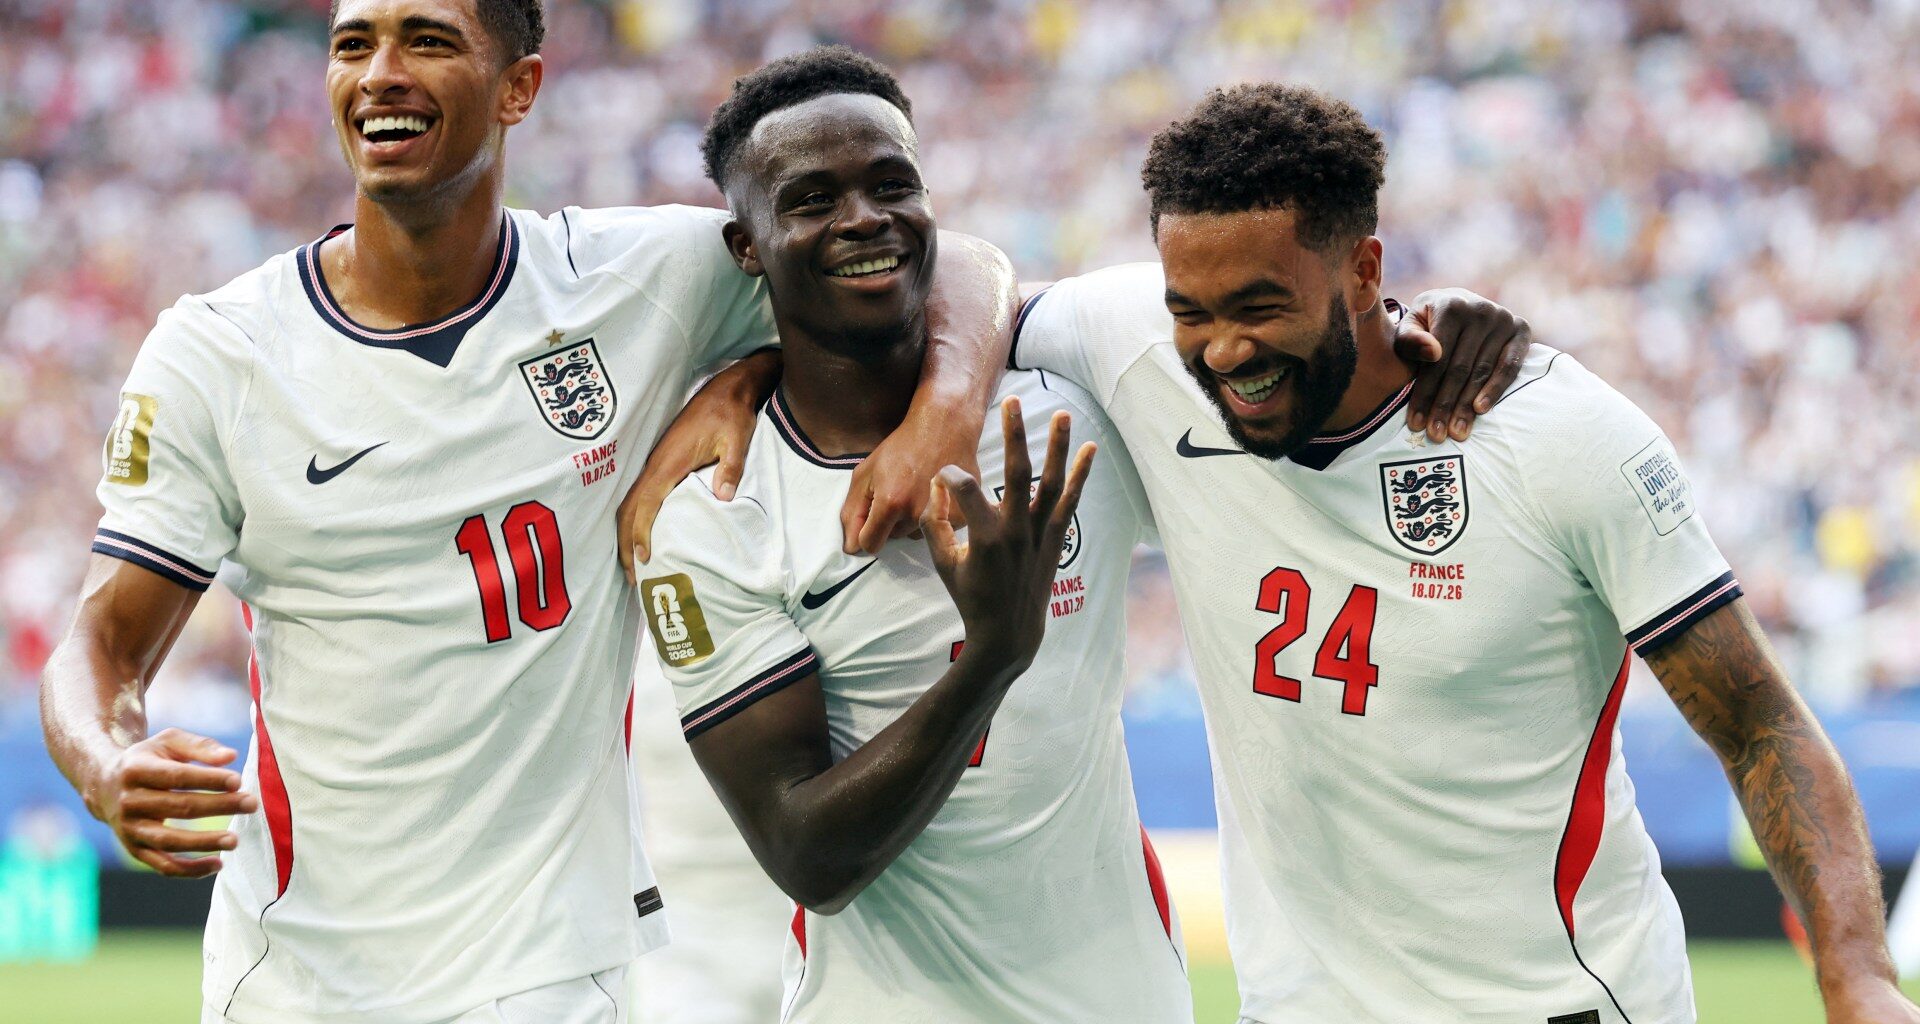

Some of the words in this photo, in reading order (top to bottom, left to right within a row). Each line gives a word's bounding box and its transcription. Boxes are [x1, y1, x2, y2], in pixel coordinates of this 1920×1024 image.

[572, 439, 618, 469] FRANCE
[581, 457, 616, 487] 18.07.26
[1643, 461, 1679, 496] UNITES
[1651, 496, 1670, 514] the
[1671, 501, 1686, 515] FIFA
[454, 499, 573, 644] 10
[1409, 562, 1465, 580] FRANCE
[1052, 575, 1085, 597] RANCE
[1411, 582, 1463, 600] 18.07.26
[667, 630, 681, 638] FIFA
[1252, 566, 1379, 717] 24
[668, 647, 696, 661] 2026
[681, 641, 693, 649] CUP
